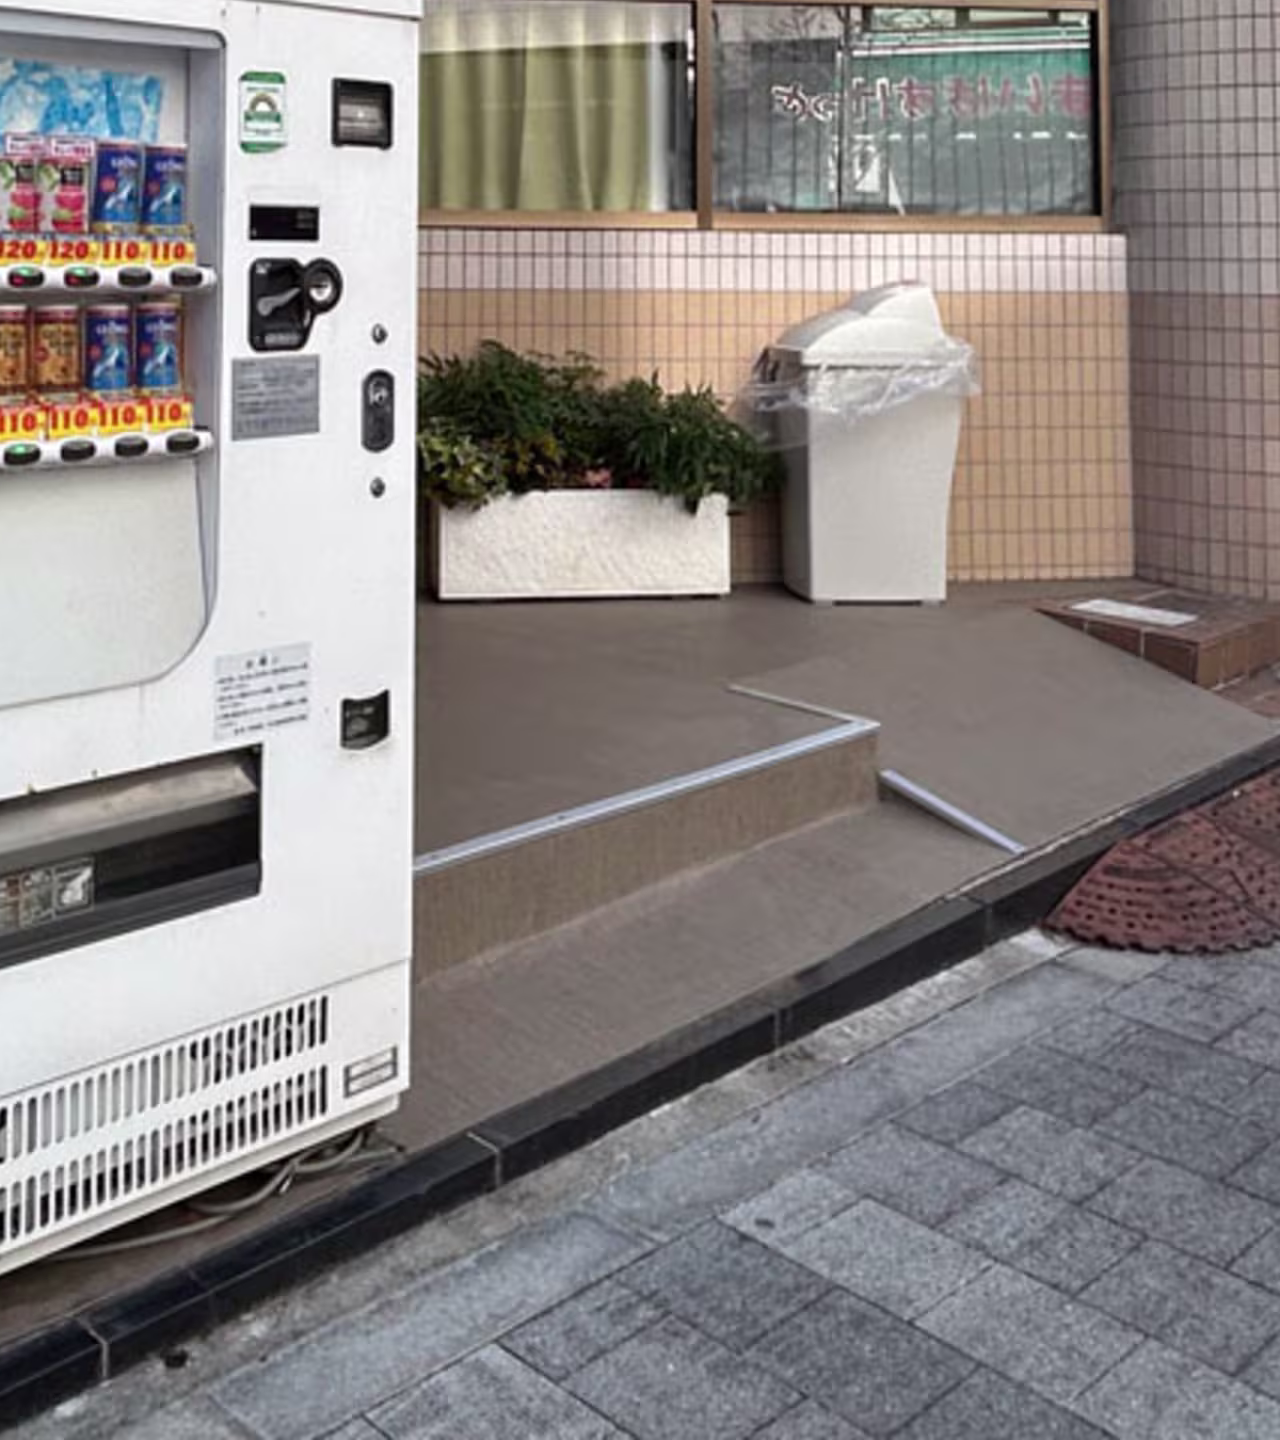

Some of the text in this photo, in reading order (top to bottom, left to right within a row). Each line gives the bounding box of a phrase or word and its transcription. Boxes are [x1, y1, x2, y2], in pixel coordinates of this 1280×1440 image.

[50, 240, 89, 260] 120
[102, 241, 140, 261] 110
[151, 241, 187, 261] 110
[51, 408, 89, 430] 110
[99, 405, 136, 427] 110
[146, 403, 182, 423] 110
